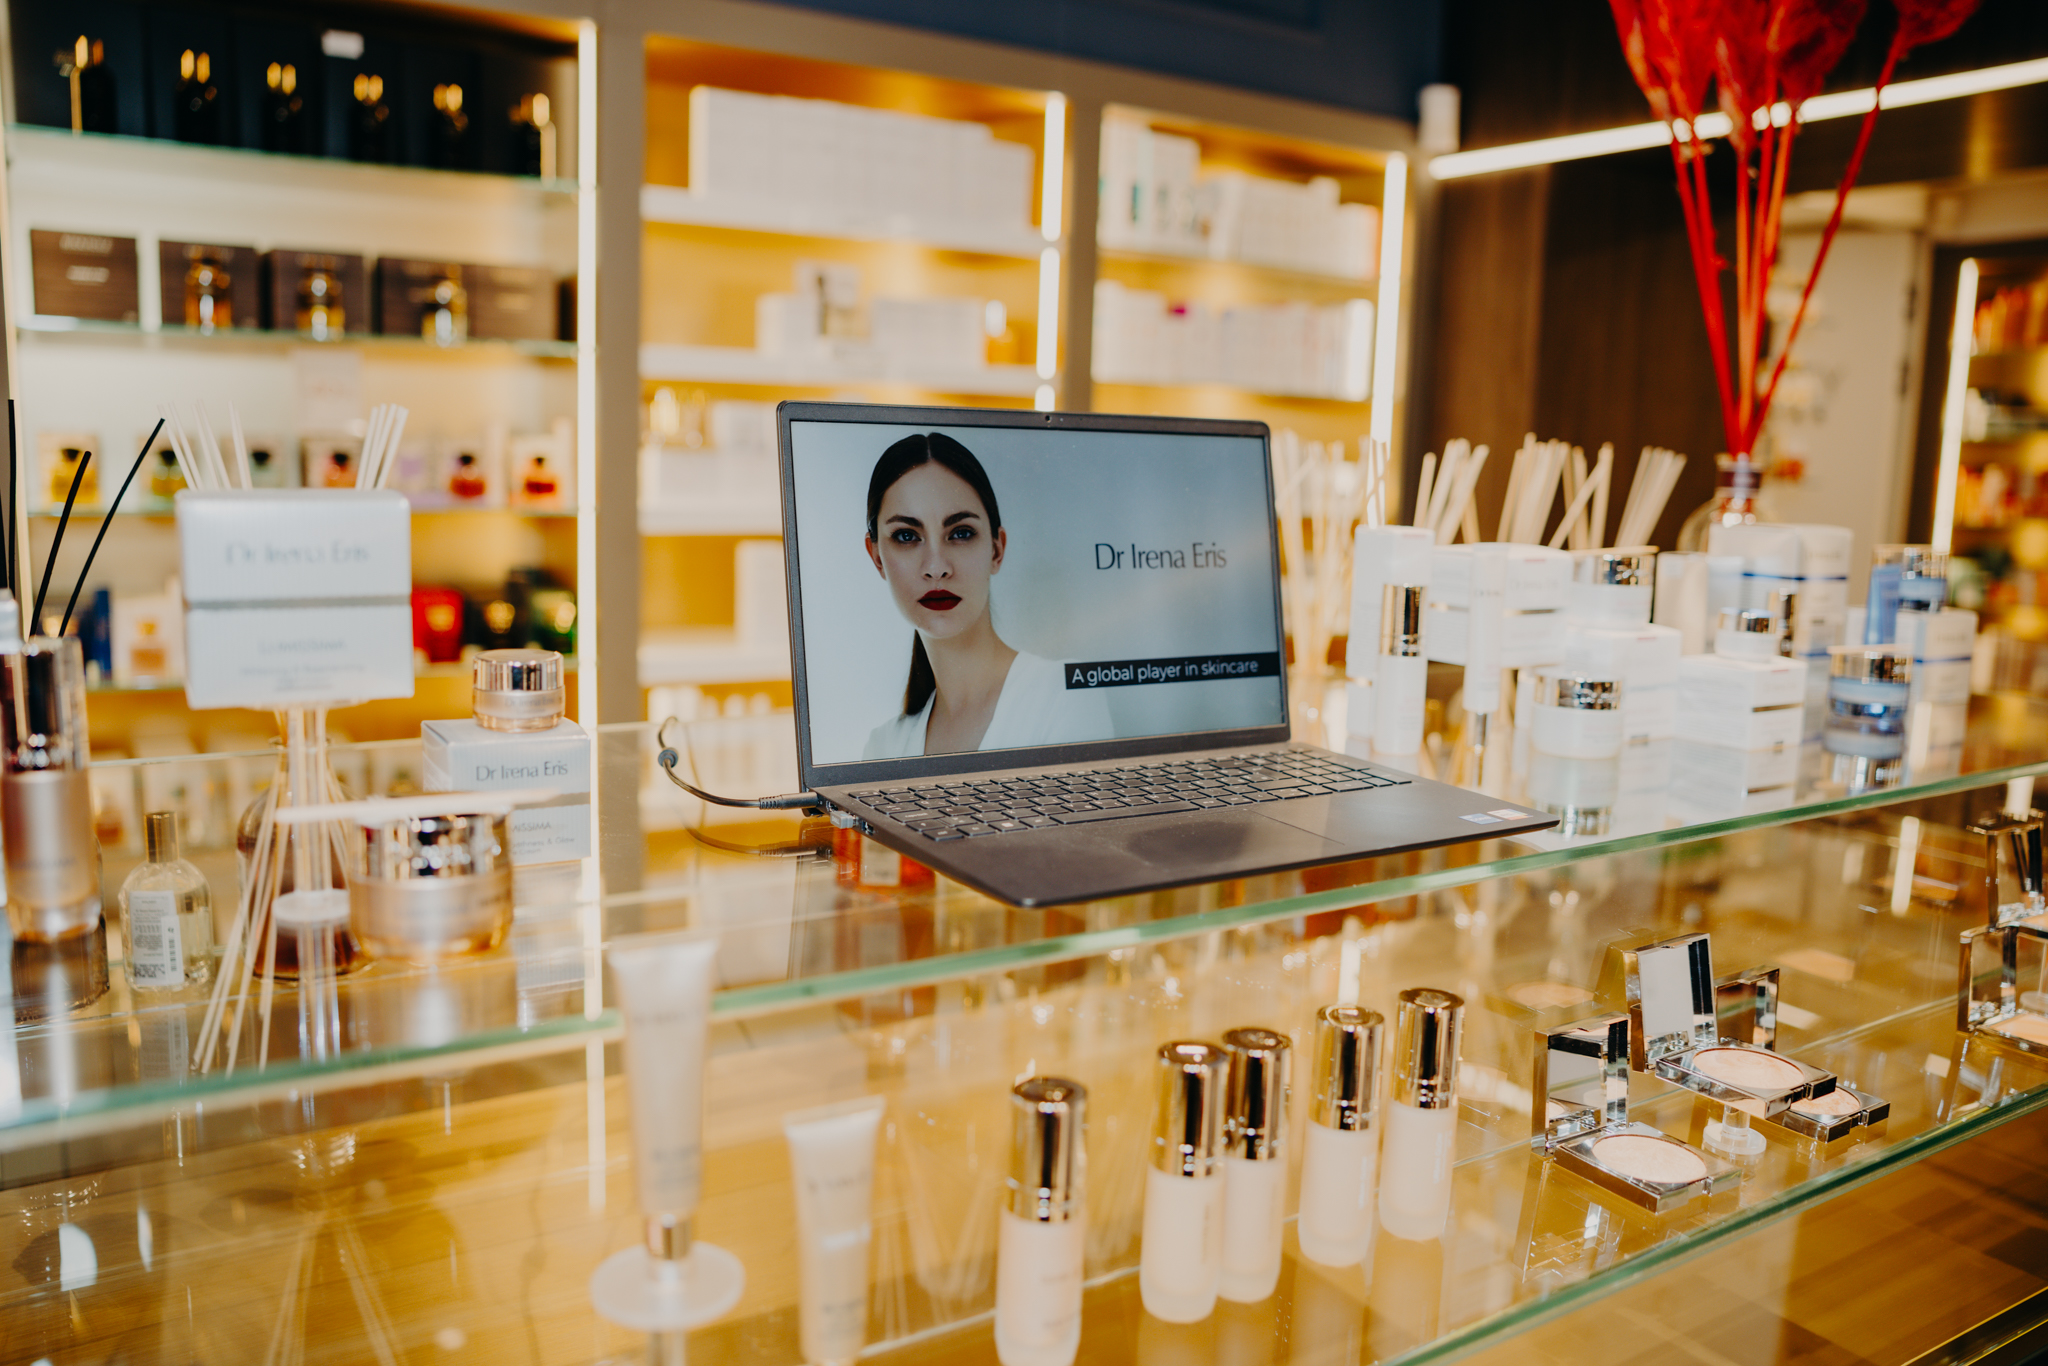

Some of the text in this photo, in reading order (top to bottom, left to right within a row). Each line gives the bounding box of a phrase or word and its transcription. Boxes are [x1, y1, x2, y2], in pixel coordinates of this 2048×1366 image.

[1095, 542, 1228, 570] Dr Irena Eris
[1071, 659, 1259, 687] A global player in skincare
[475, 761, 568, 782] Dr Irena Eris
